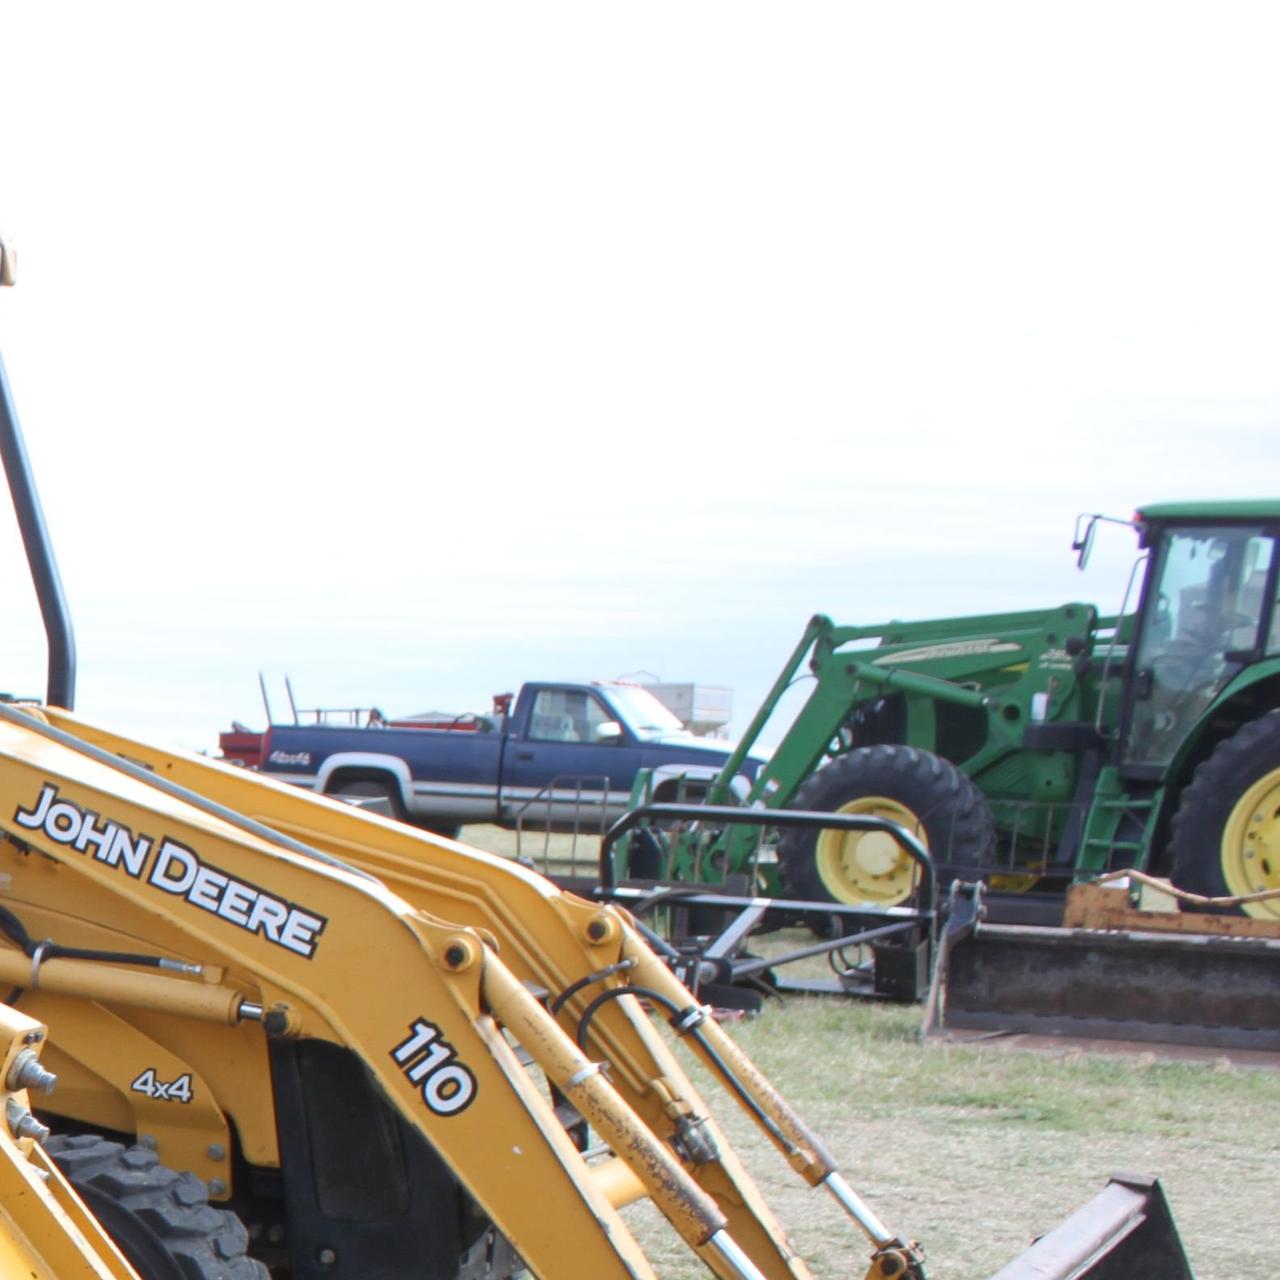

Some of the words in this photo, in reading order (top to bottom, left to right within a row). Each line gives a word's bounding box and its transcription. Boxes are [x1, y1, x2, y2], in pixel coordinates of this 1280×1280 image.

[15, 783, 151, 877] JOHN
[148, 836, 328, 959] DEERE
[131, 1067, 193, 1103] 4x4
[389, 1017, 478, 1117] 110
